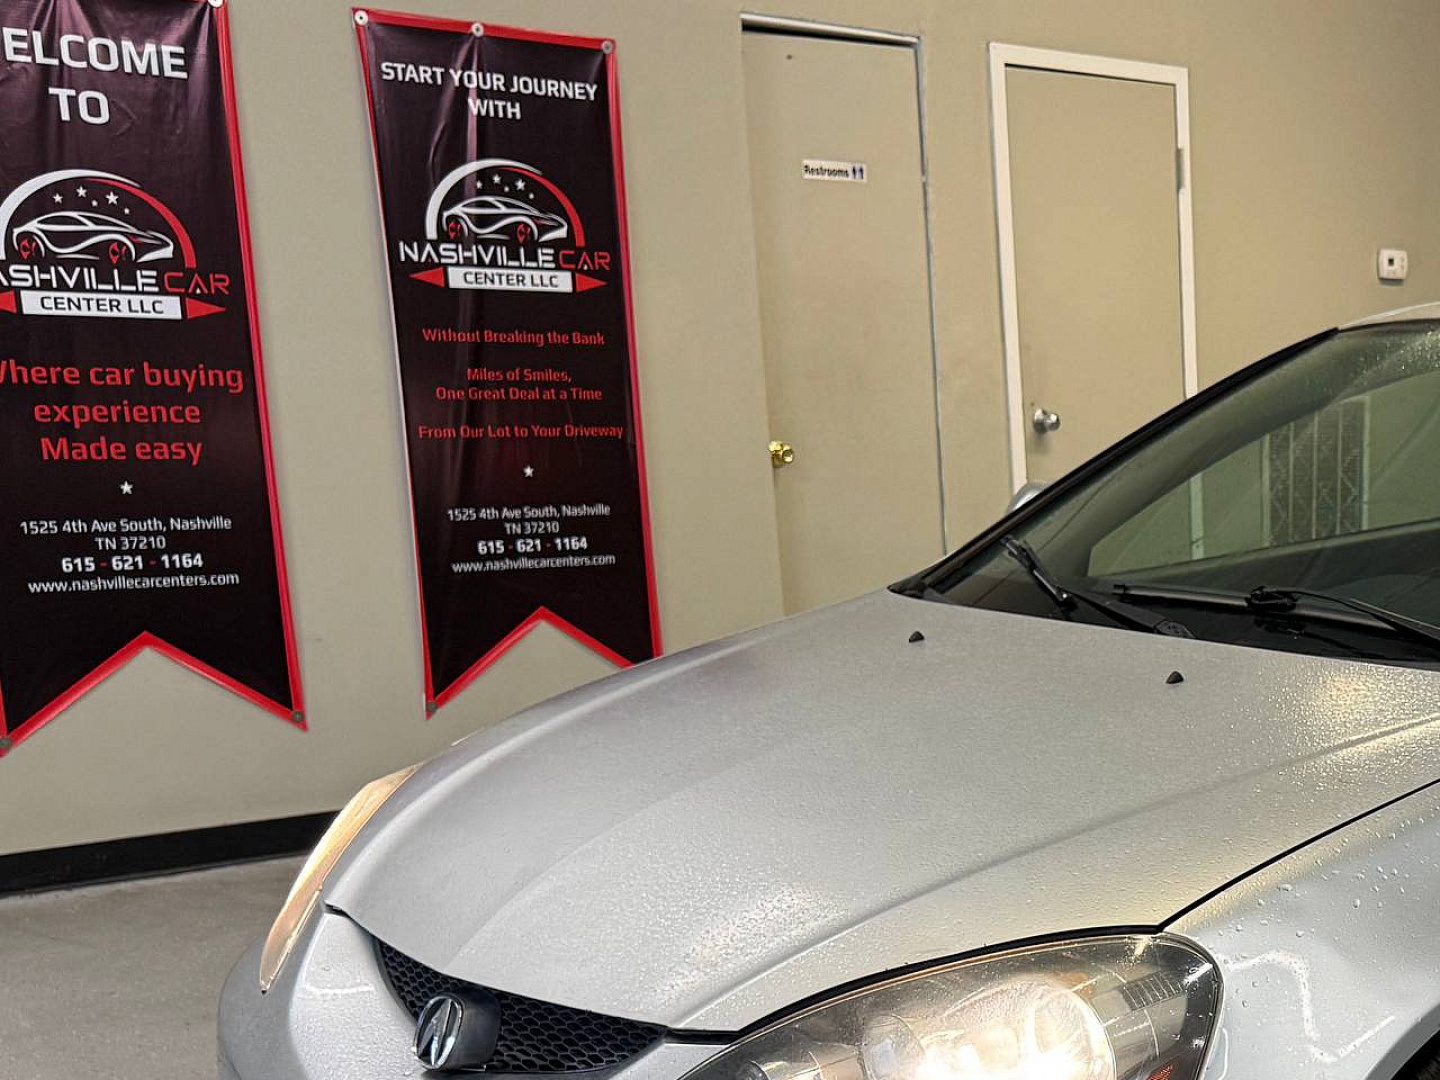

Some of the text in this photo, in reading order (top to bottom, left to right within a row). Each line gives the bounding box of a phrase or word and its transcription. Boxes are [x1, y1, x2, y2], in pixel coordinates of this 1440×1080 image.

[380, 61, 598, 101] START YOUR JOURNEY
[48, 87, 110, 125] TO
[467, 97, 521, 120] WITH
[399, 240, 611, 271] NASHVILLE CAR
[164, 271, 231, 296] CAR
[463, 271, 559, 288] CENTER LLC
[40, 296, 165, 315] CENTER LLC
[421, 328, 605, 348] Without Breaking the Bank
[89, 366, 135, 387] car
[143, 361, 245, 394] buying
[467, 367, 572, 384] Miles of Smiles,
[435, 387, 603, 401] One Great Deal at a Time
[34, 399, 201, 430] experience
[418, 423, 624, 439] From Our Lot to Your Driveway
[40, 436, 203, 466] Made easy
[447, 507, 477, 522] 1525
[478, 507, 500, 520] 4th
[502, 506, 523, 520] Ave
[562, 502, 611, 517] Nashville
[20, 515, 233, 535] 1525 4th Ave South, Nashville
[504, 520, 560, 535] TN 37210
[94, 535, 167, 551] TN 37210
[477, 540, 505, 555] 615
[516, 538, 542, 553] 621
[555, 536, 588, 551] 1164
[61, 556, 97, 573] 615
[111, 555, 144, 571] 621
[160, 552, 204, 570] 1164
[27, 572, 241, 594] www.nashvillecarcenters.com
